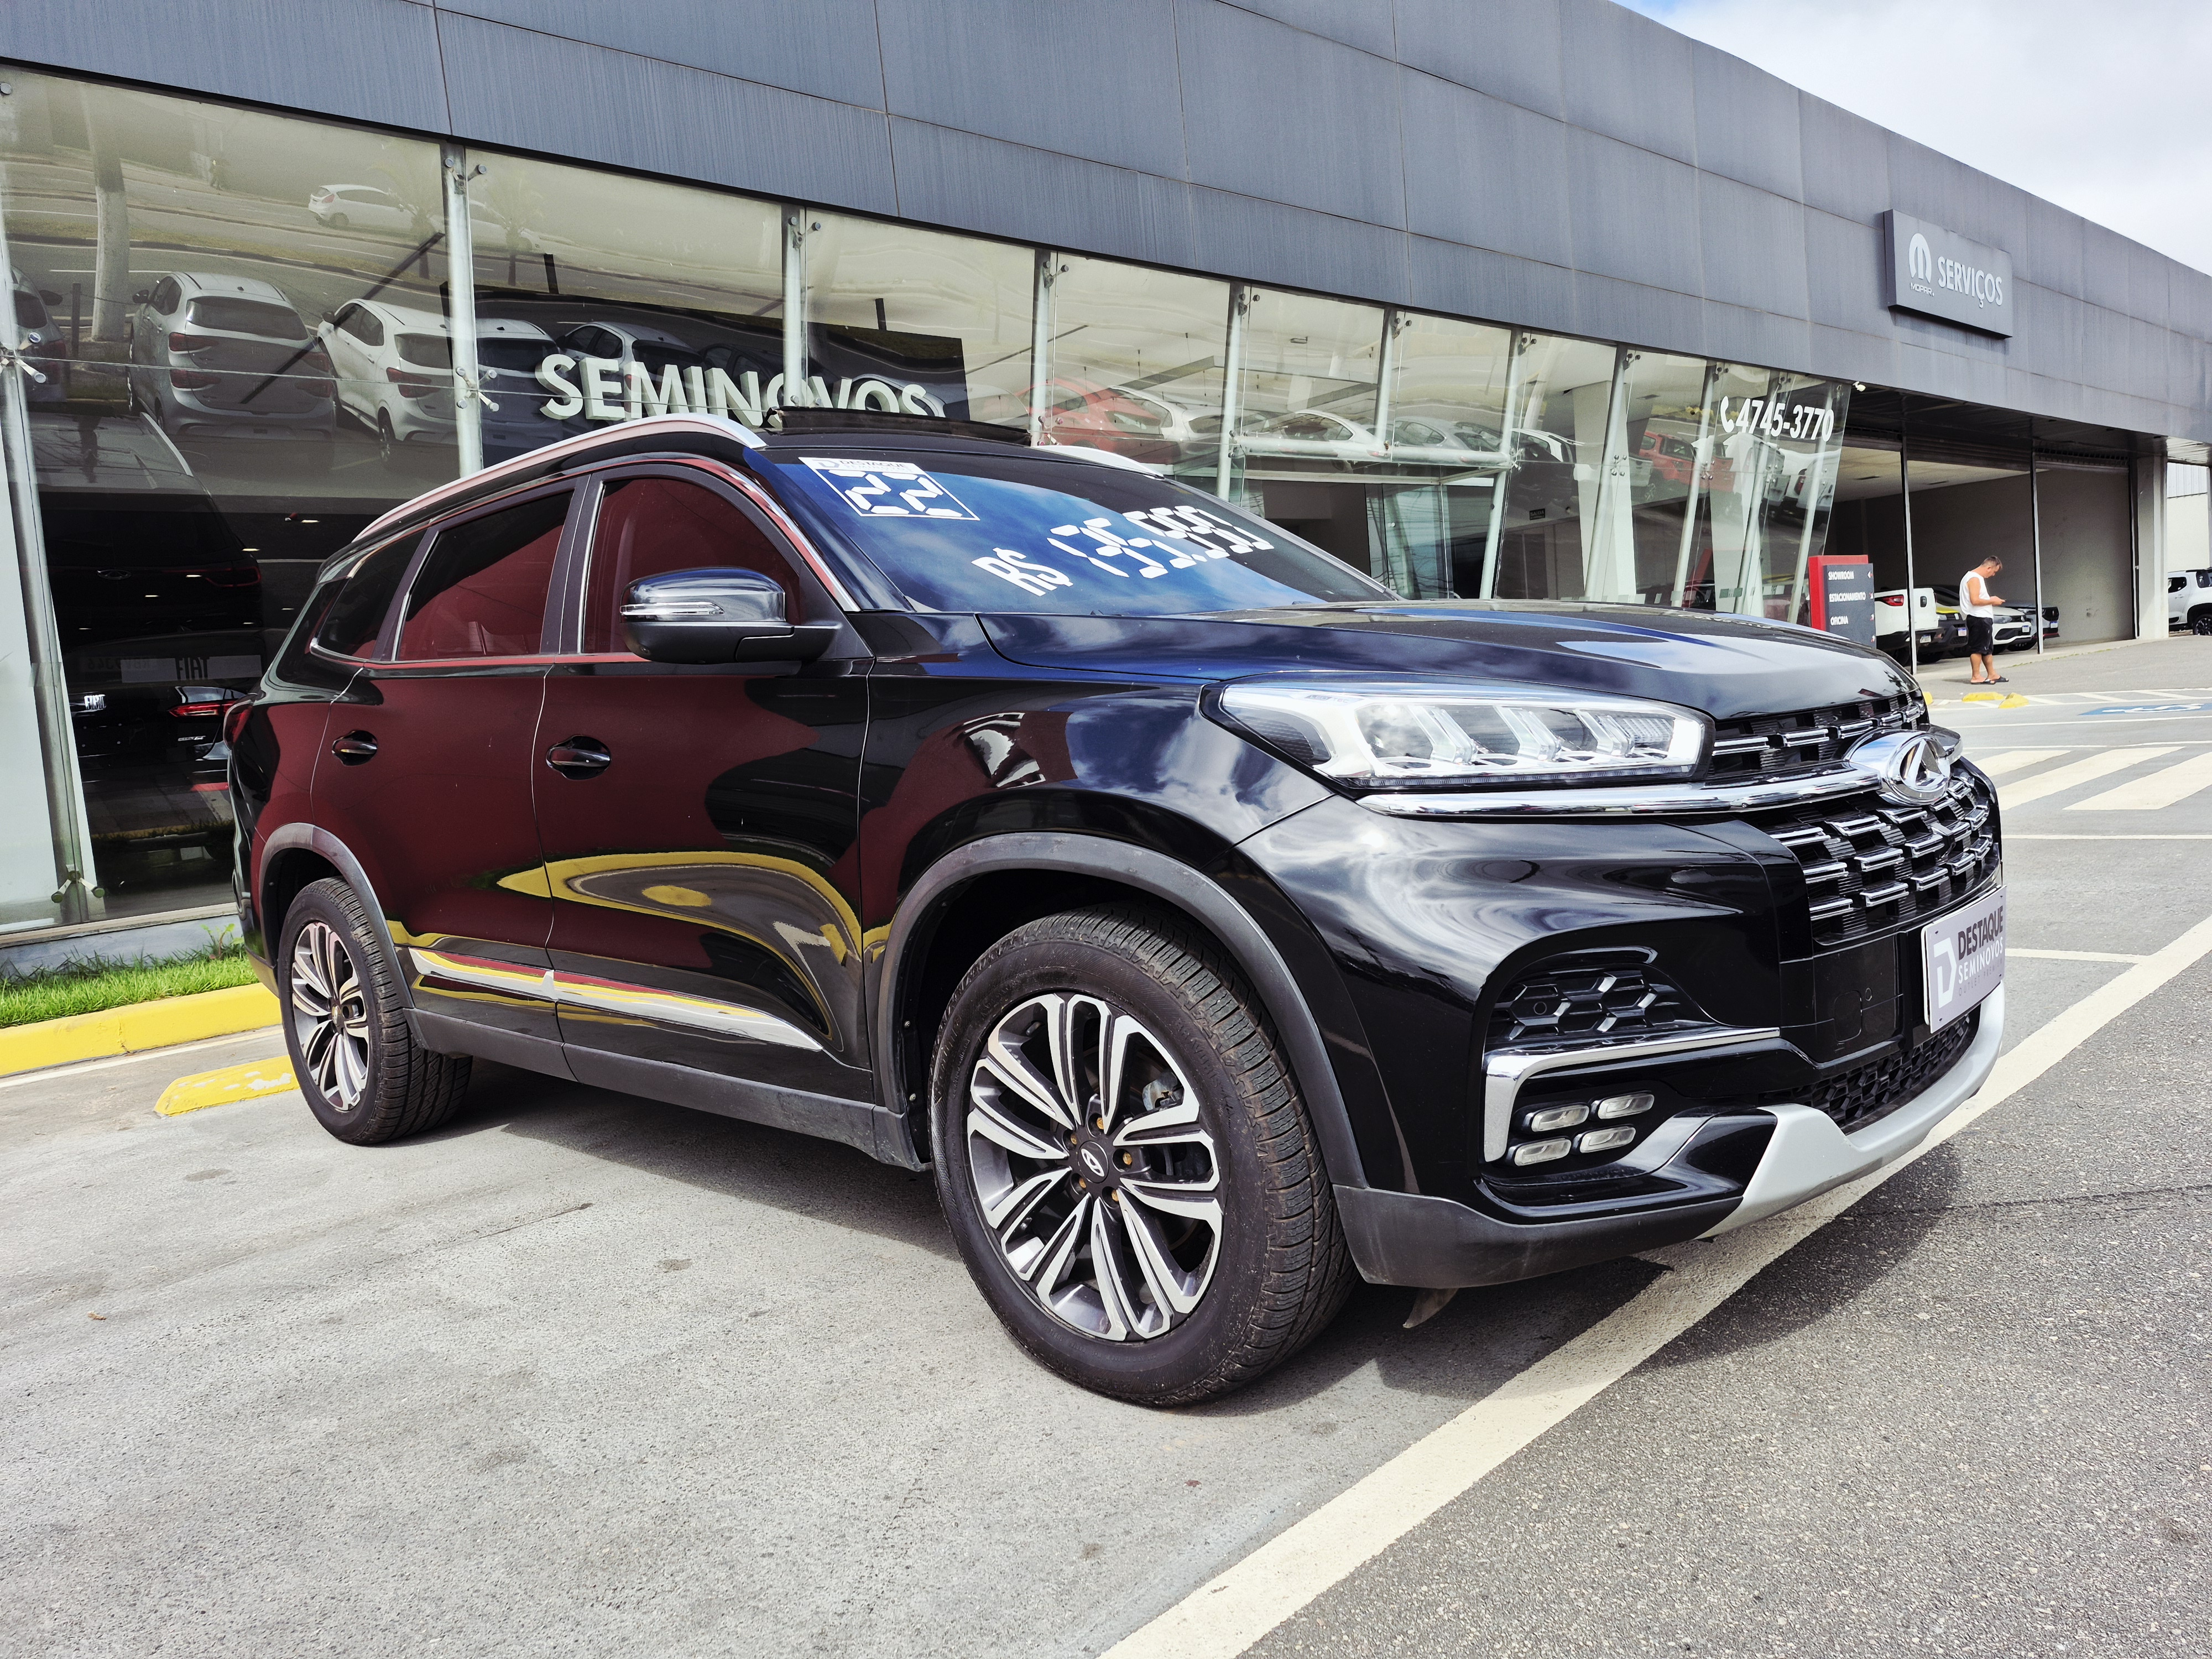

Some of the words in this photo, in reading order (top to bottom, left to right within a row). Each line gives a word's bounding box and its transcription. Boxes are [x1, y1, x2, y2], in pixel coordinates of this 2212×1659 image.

[1938, 257, 2002, 309] SERVIÇOS
[1736, 398, 1834, 442] 4745-3770
[828, 469, 963, 517] 22
[971, 547, 1074, 597] R$
[1828, 571, 1854, 580] SHOWROOM
[1829, 592, 1866, 602] ESTACIONAMENTO
[1830, 615, 1849, 625] OFICINA
[176, 656, 210, 680] FIAT
[1958, 905, 2003, 961] DESTAQUE
[1958, 936, 2003, 984] SEMINOVOS
[1958, 975, 1980, 996] OUTLET
